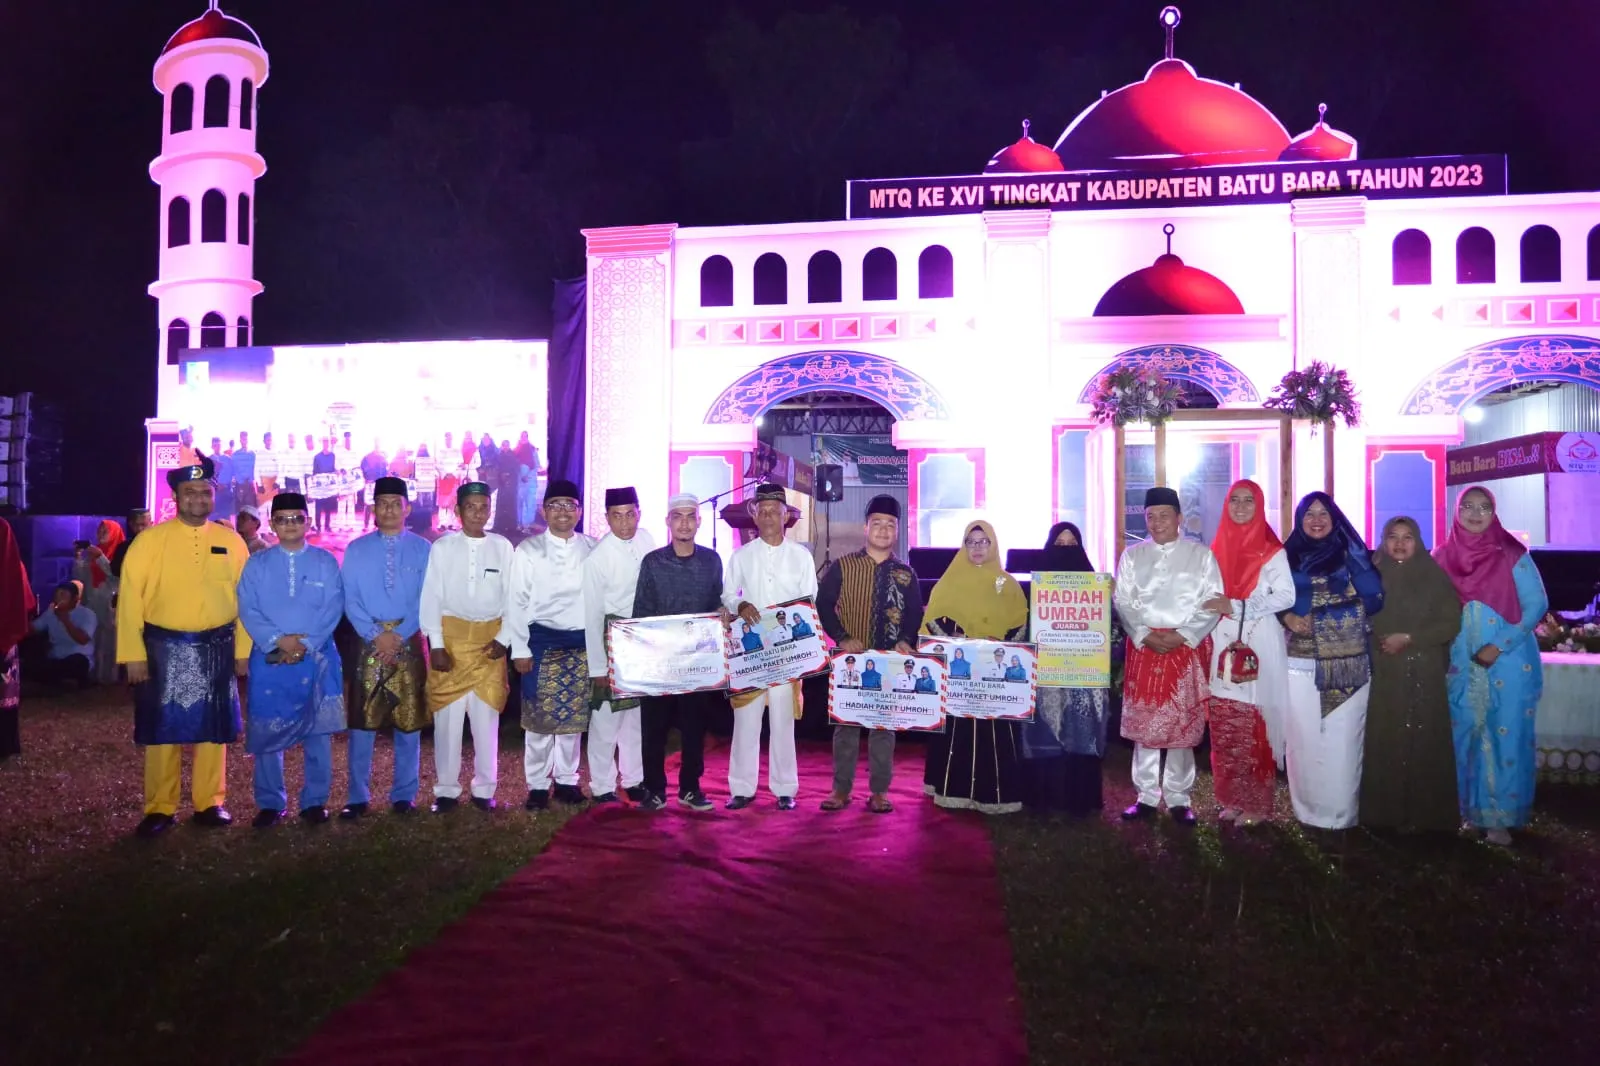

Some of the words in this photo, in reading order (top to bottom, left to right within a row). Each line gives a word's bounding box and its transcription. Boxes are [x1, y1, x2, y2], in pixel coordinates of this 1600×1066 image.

[869, 188, 912, 209] MTQ
[918, 187, 945, 207] KE
[950, 185, 984, 207] XVI
[990, 181, 1081, 205] TINGKAT
[1087, 176, 1212, 202] KABUPATEN
[1218, 171, 1275, 197] BATU
[1282, 169, 1341, 193] BARA
[1347, 166, 1424, 191] TAHUN
[1430, 164, 1483, 187] 2023
[1449, 460, 1472, 476] Batu
[1473, 455, 1496, 472] Bara
[1037, 588, 1103, 604] HADIAH
[1038, 606, 1103, 621] UMRAH
[1055, 622, 1080, 630] JUARA
[735, 664, 763, 676] HADIAH
[763, 658, 784, 668] PAKET
[786, 650, 812, 663] UMROH
[964, 692, 987, 700] PAKET
[989, 694, 1018, 702] UMROH
[845, 701, 874, 710] HADIAH
[875, 703, 898, 711] PAKET
[900, 705, 928, 713] UMROH
